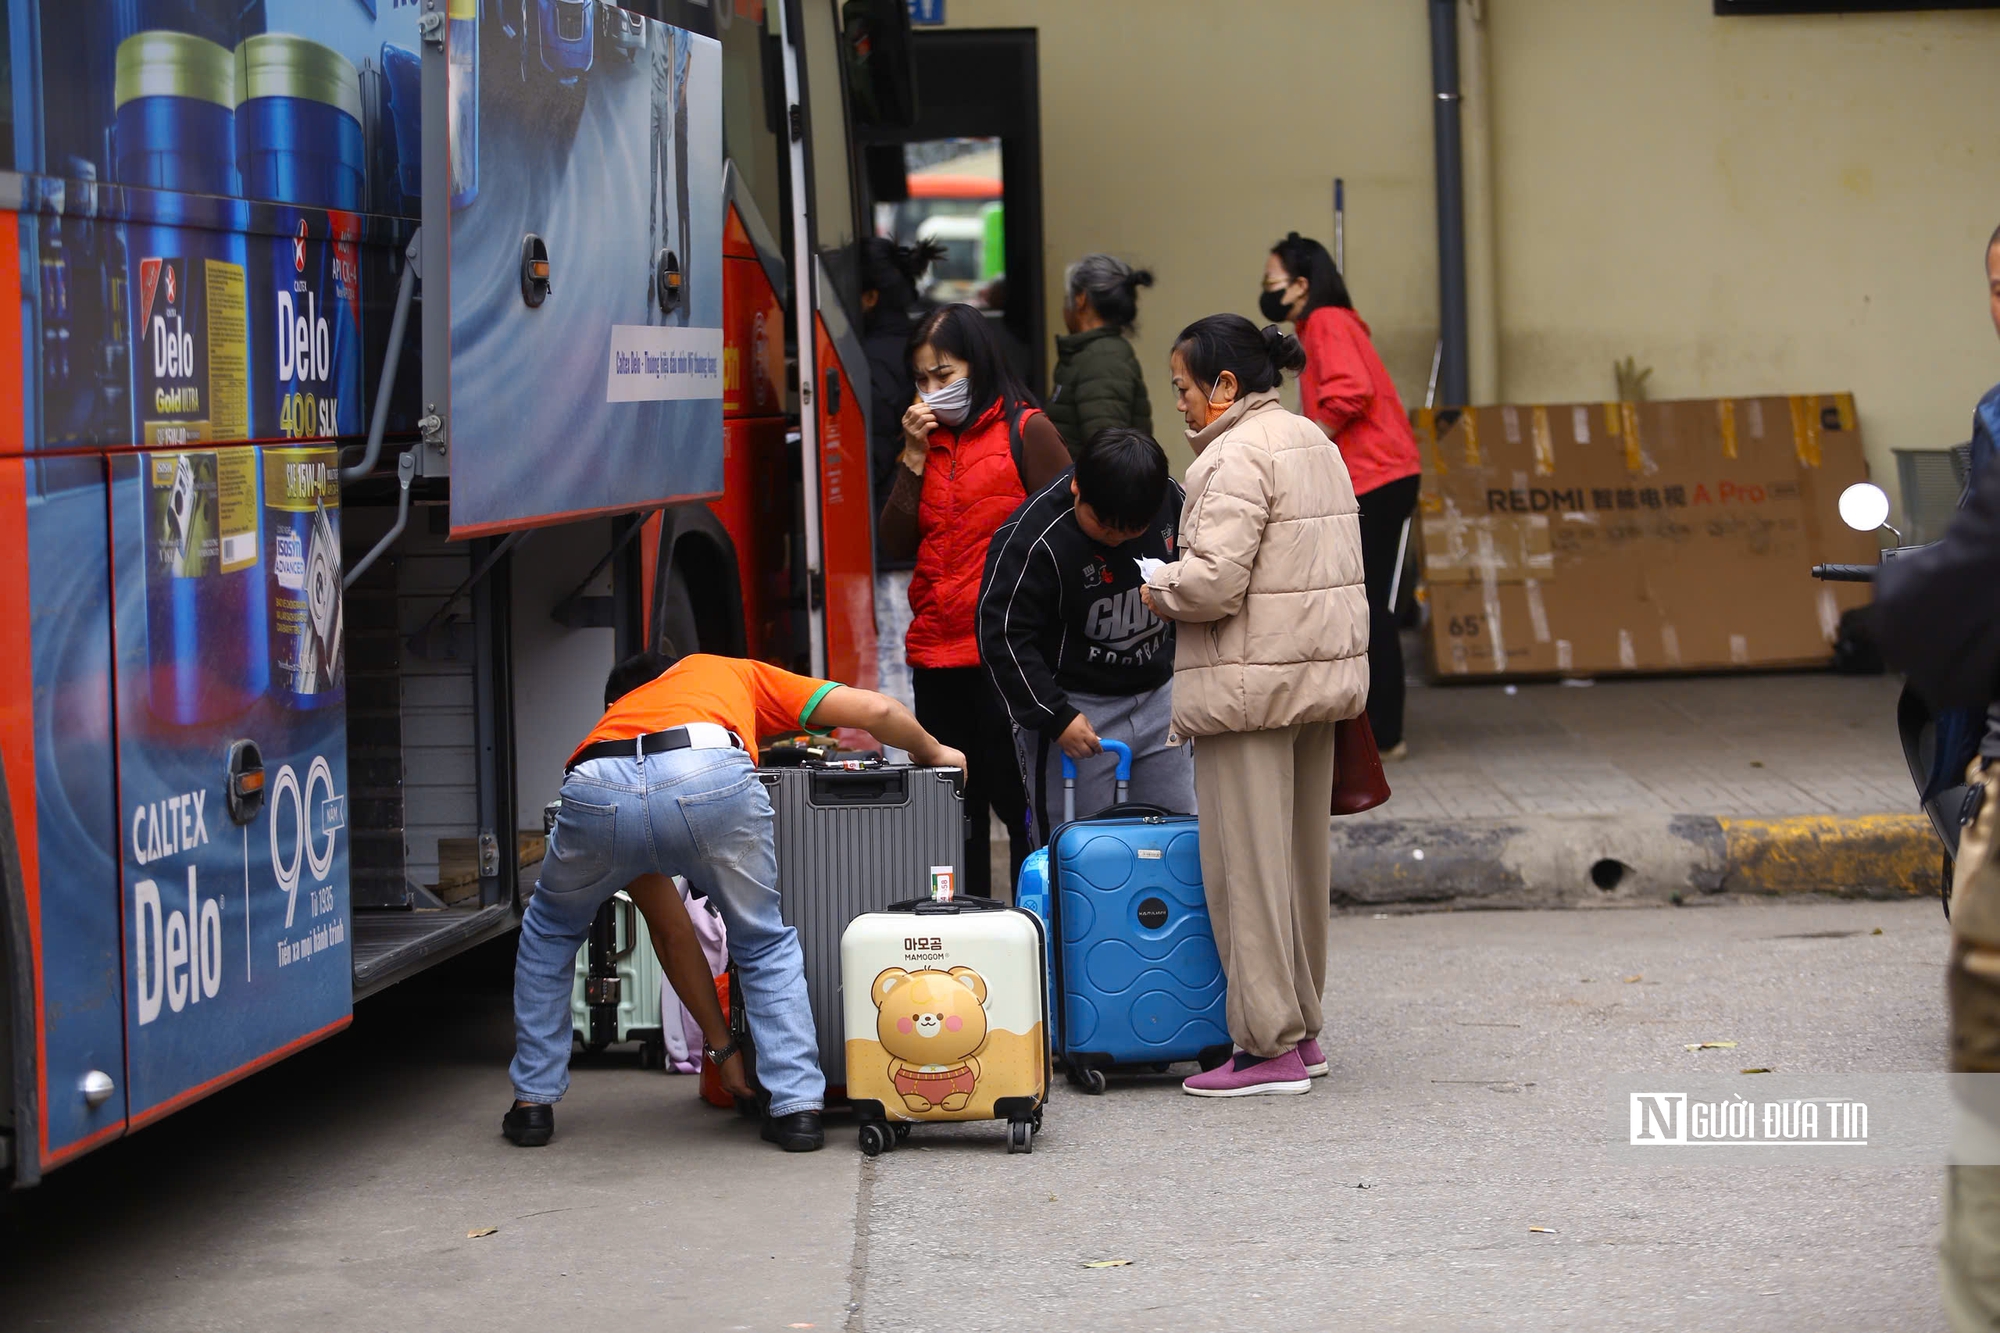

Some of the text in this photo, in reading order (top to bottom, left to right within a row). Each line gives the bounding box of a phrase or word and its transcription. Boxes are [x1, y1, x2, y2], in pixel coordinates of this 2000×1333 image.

[332, 257, 342, 281] API
[154, 315, 194, 378] Delo
[278, 290, 330, 382] Delo
[156, 387, 181, 413] Gold
[280, 392, 338, 438] 400 SLK
[286, 463, 296, 498] SAE
[298, 462, 327, 499] 15W-40
[1487, 488, 1585, 512] REDMI
[1692, 482, 1714, 507] A
[1718, 480, 1767, 506] Pro
[275, 560, 304, 575] ADVANCED
[133, 789, 209, 866] CALTEX
[319, 885, 334, 914] 1935
[135, 865, 222, 1026] Delo
[277, 937, 292, 968] Tiến
[300, 930, 313, 963] mọi
[312, 923, 329, 953] hành
[329, 917, 344, 947] trình
[904, 937, 943, 951] 마모곰
[904, 953, 945, 961] MAMOGOM
